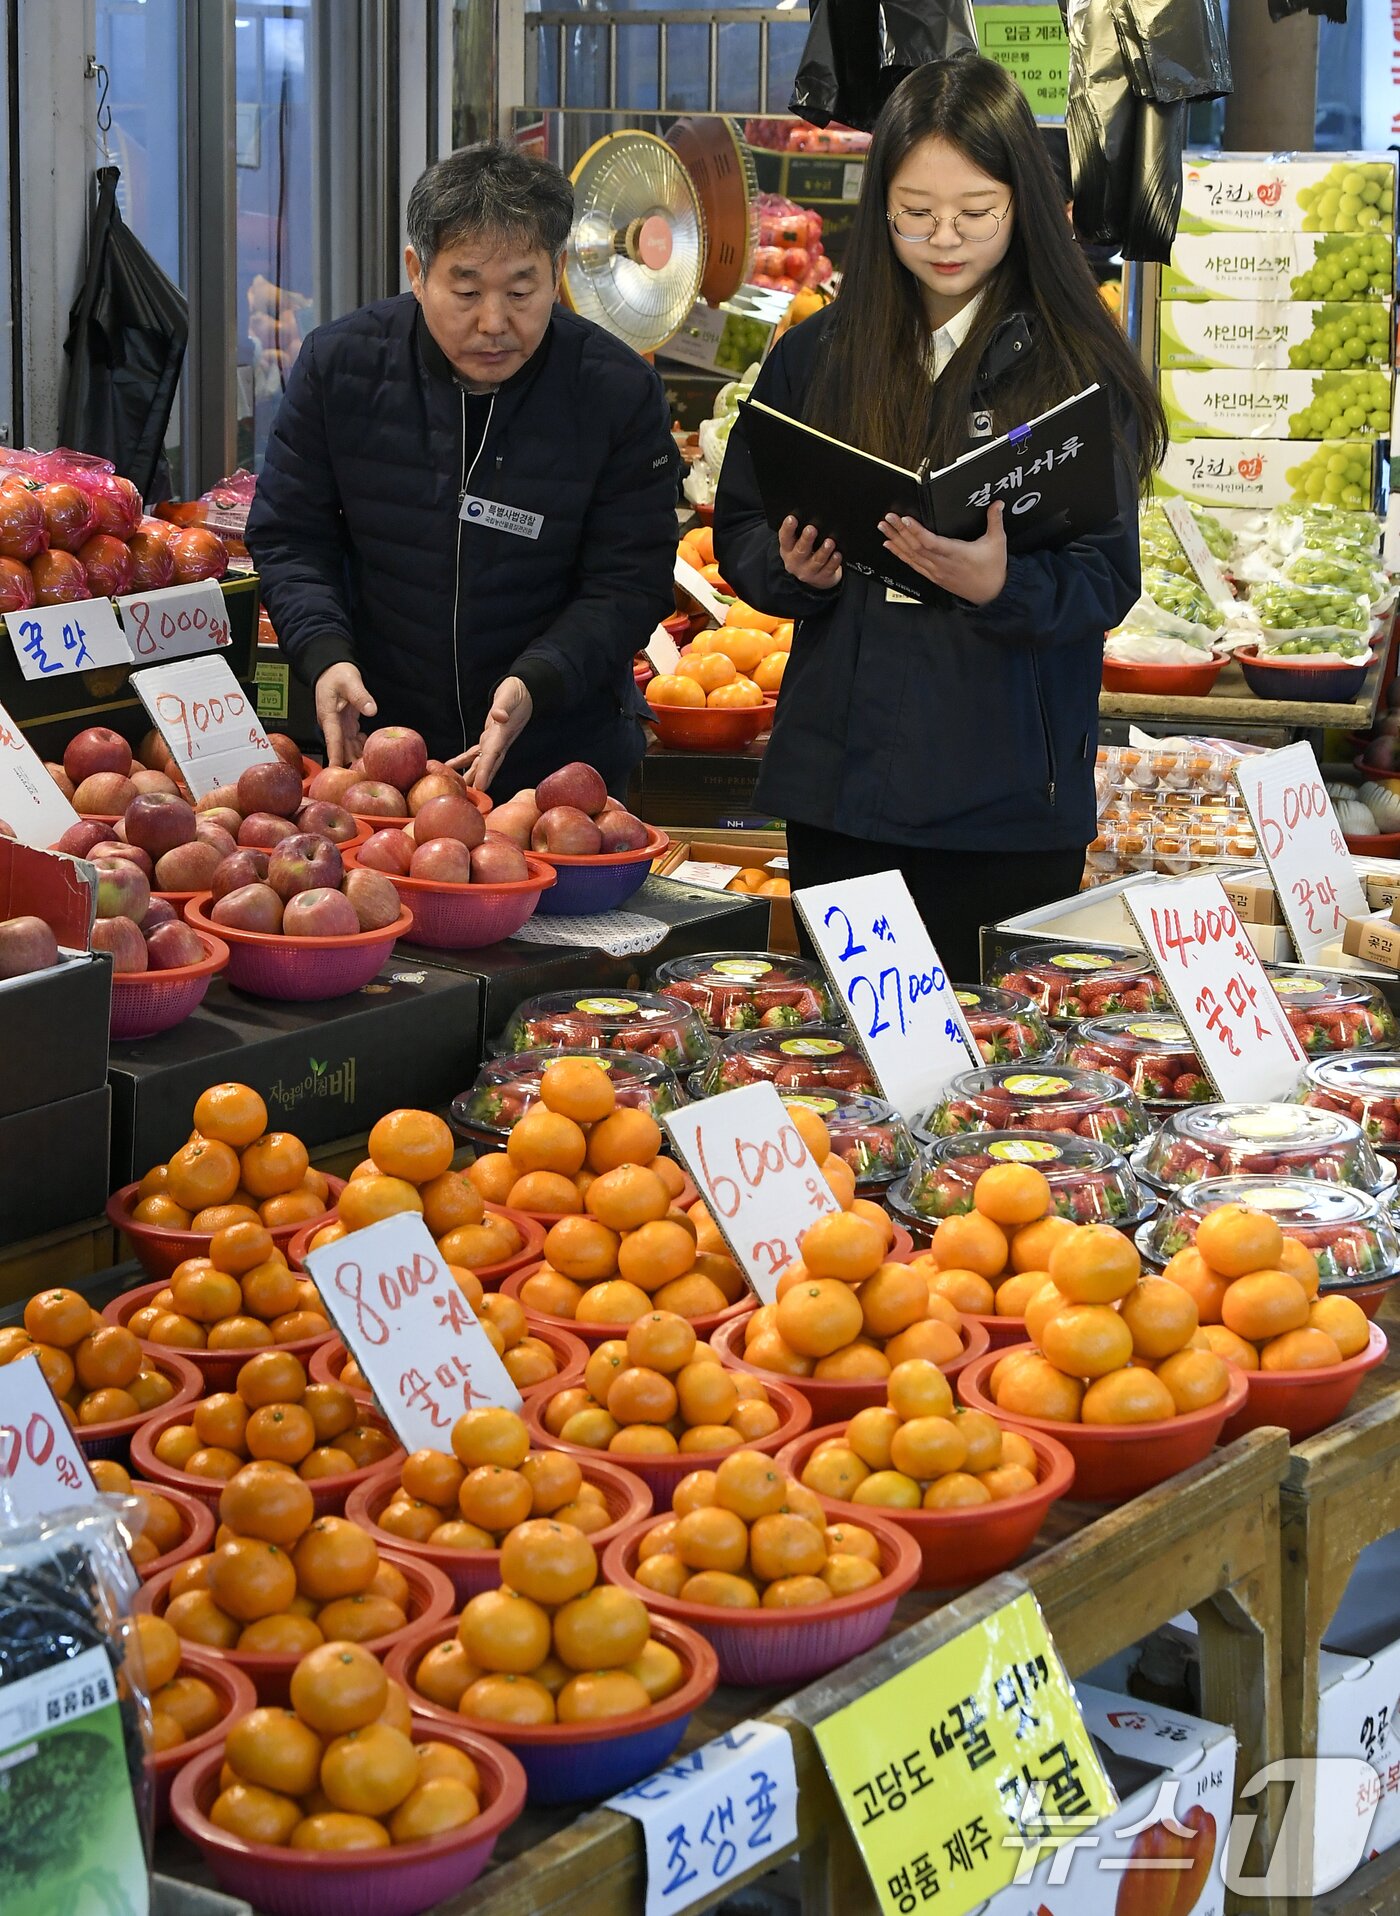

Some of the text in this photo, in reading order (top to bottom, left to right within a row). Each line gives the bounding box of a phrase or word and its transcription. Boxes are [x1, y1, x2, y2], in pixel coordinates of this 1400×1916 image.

[1004, 26, 1062, 41] 입금 계좌
[992, 52, 1030, 63] 국민은행
[1021, 70, 1042, 80] 102
[1048, 70, 1063, 80] 01
[1205, 256, 1291, 274] 샤인머스켓
[1203, 325, 1289, 342] 샤인머스켓
[1203, 393, 1289, 411] 샤인머스켓
[652, 455, 669, 469] NAQS
[966, 435, 1084, 507] 결재서류
[487, 504, 536, 526] 특별사법경찰
[727, 820, 744, 828] NH
[824, 906, 867, 962] 2
[1368, 935, 1393, 953] 곶감
[853, 1750, 934, 1827] 고당도
[1197, 1770, 1223, 1797] 10 kg
[887, 1852, 941, 1914] 명품
[942, 1815, 993, 1872] 제주
